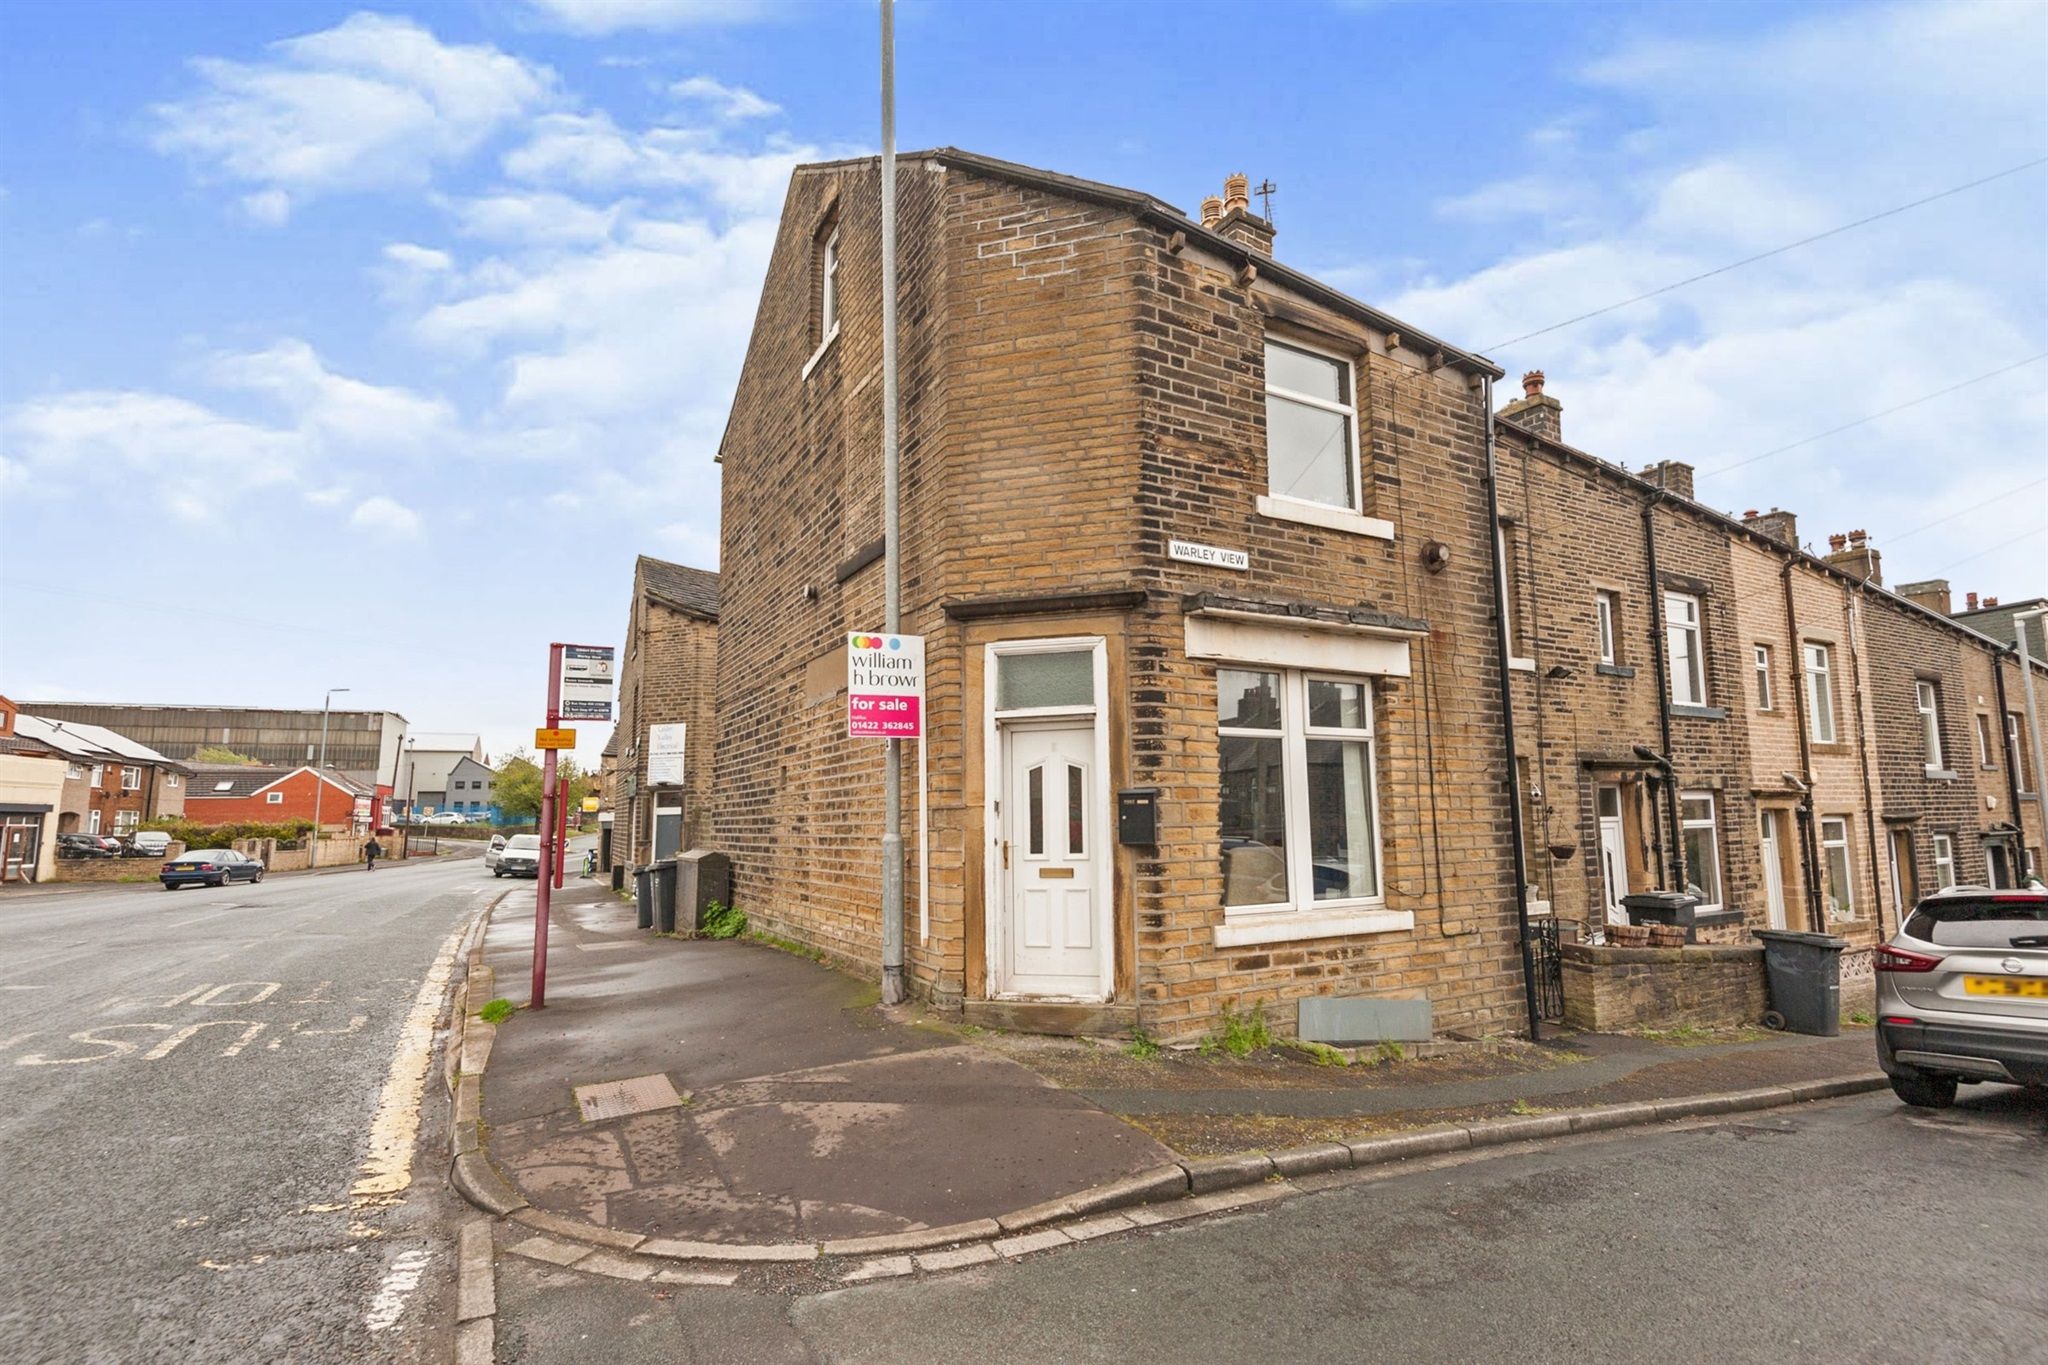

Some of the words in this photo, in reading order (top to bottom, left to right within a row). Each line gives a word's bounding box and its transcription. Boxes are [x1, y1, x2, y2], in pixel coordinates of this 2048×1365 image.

[1173, 544, 1215, 561] WARLEY
[1220, 552, 1245, 565] VIEW
[852, 652, 912, 669] william
[854, 669, 864, 685] h
[852, 697, 875, 710] for
[879, 698, 908, 711] sale
[851, 721, 878, 729] 01422
[882, 722, 914, 730] 362845
